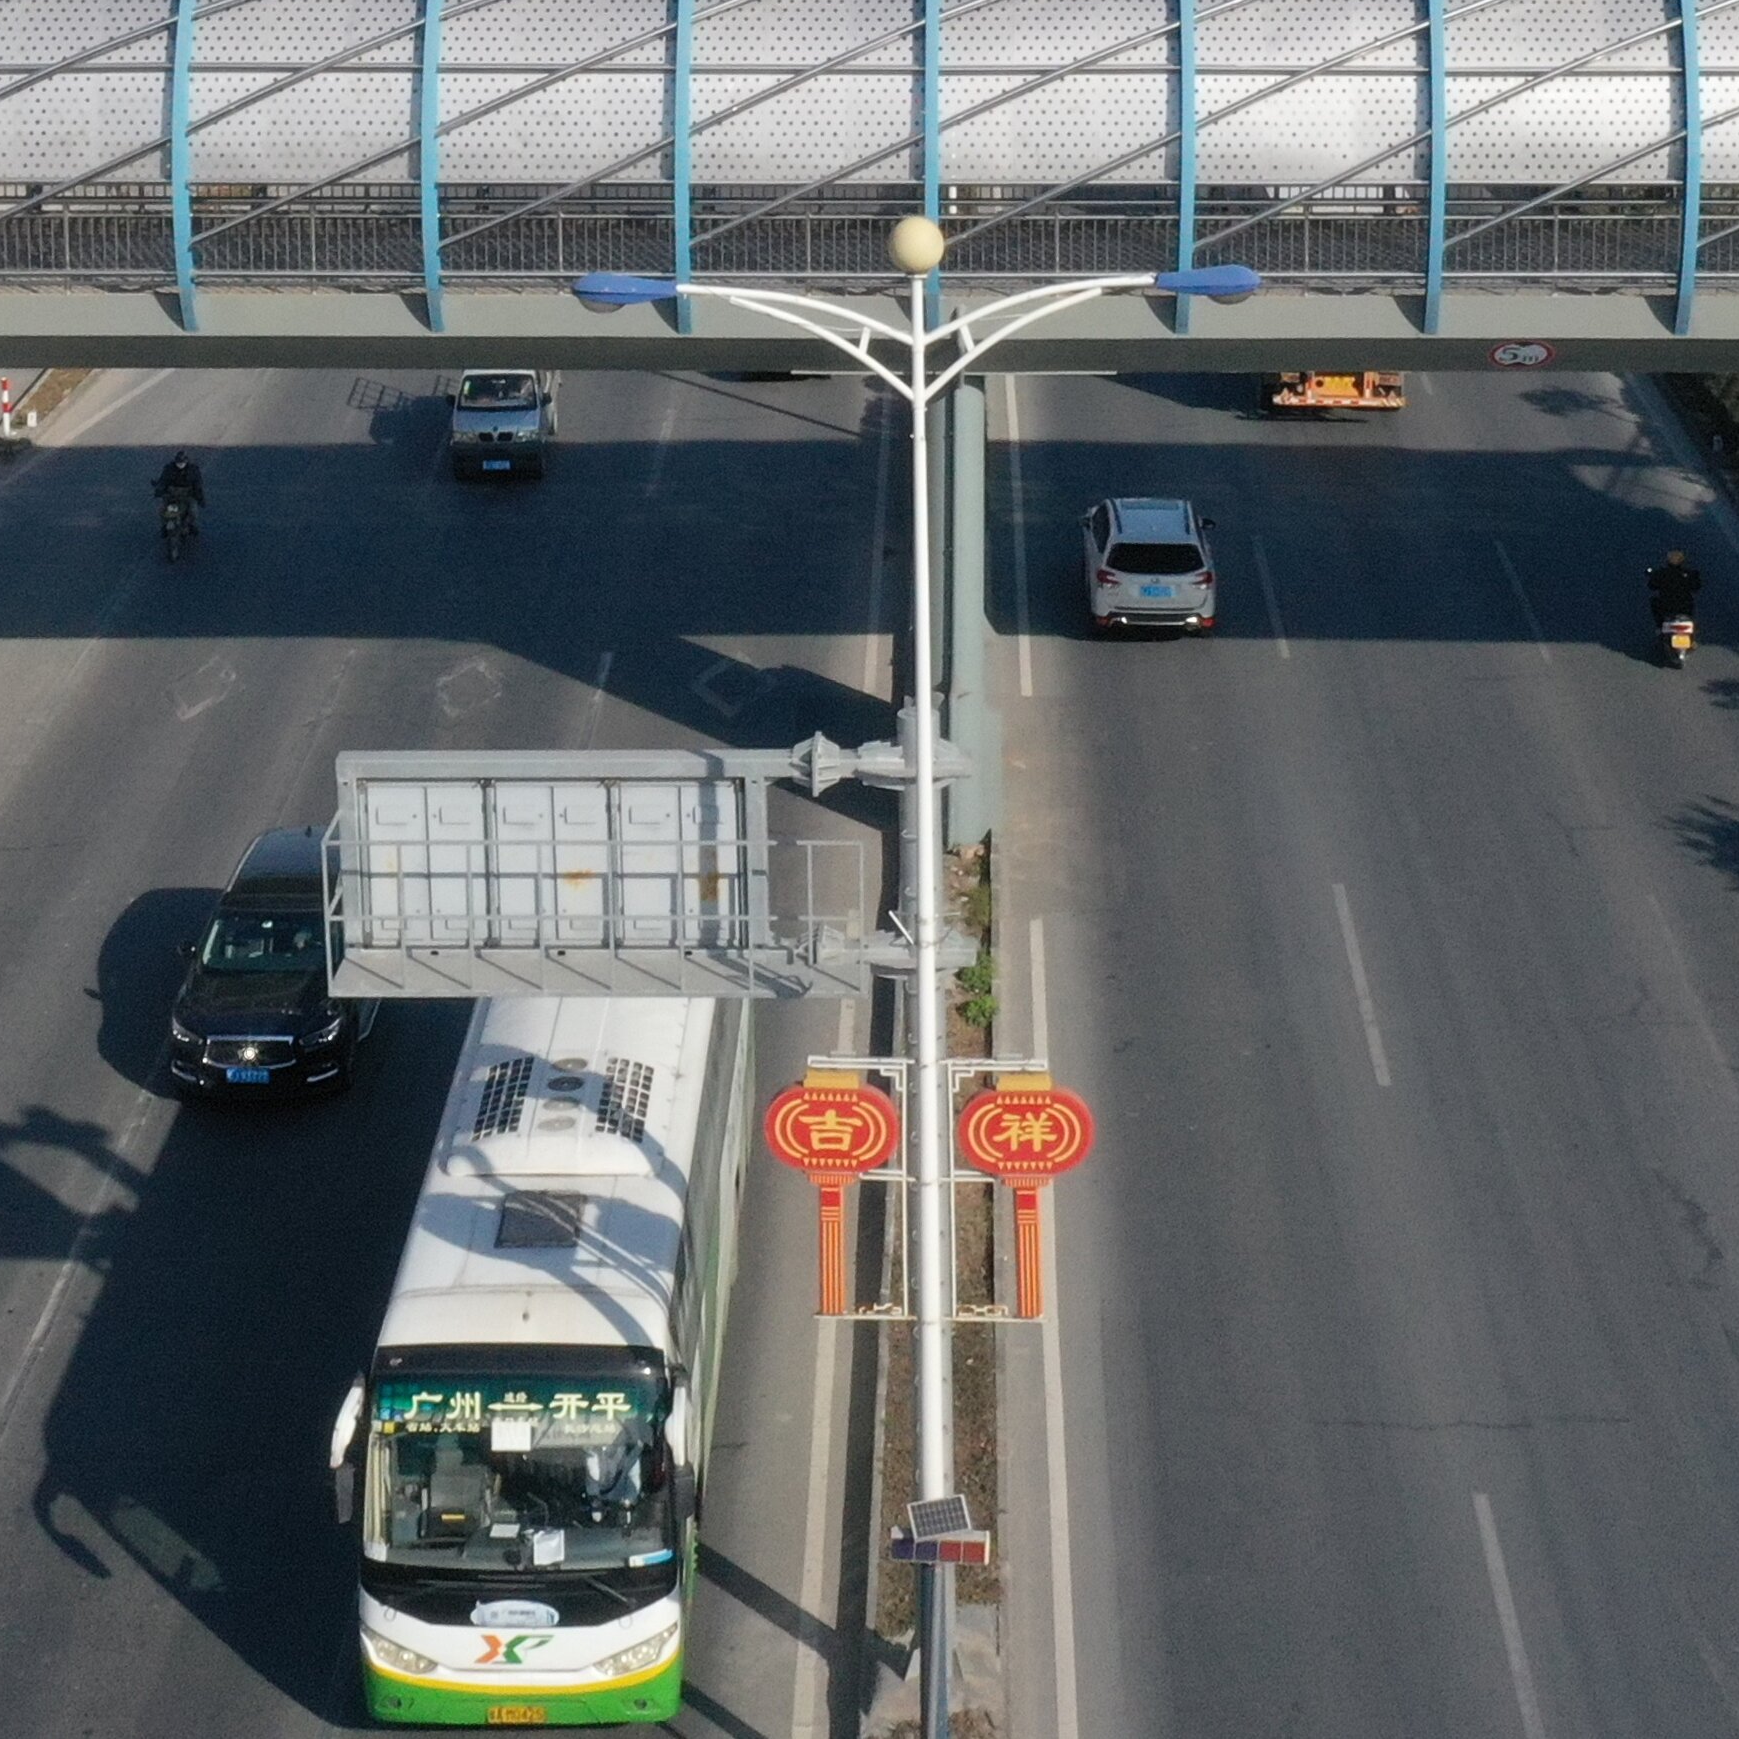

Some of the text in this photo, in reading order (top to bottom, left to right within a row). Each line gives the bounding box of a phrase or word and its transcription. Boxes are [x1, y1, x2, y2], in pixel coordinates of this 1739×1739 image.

[799, 1110, 863, 1152] 吉
[993, 1111, 1057, 1153] 祥
[404, 1391, 632, 1421] 广州 开平
